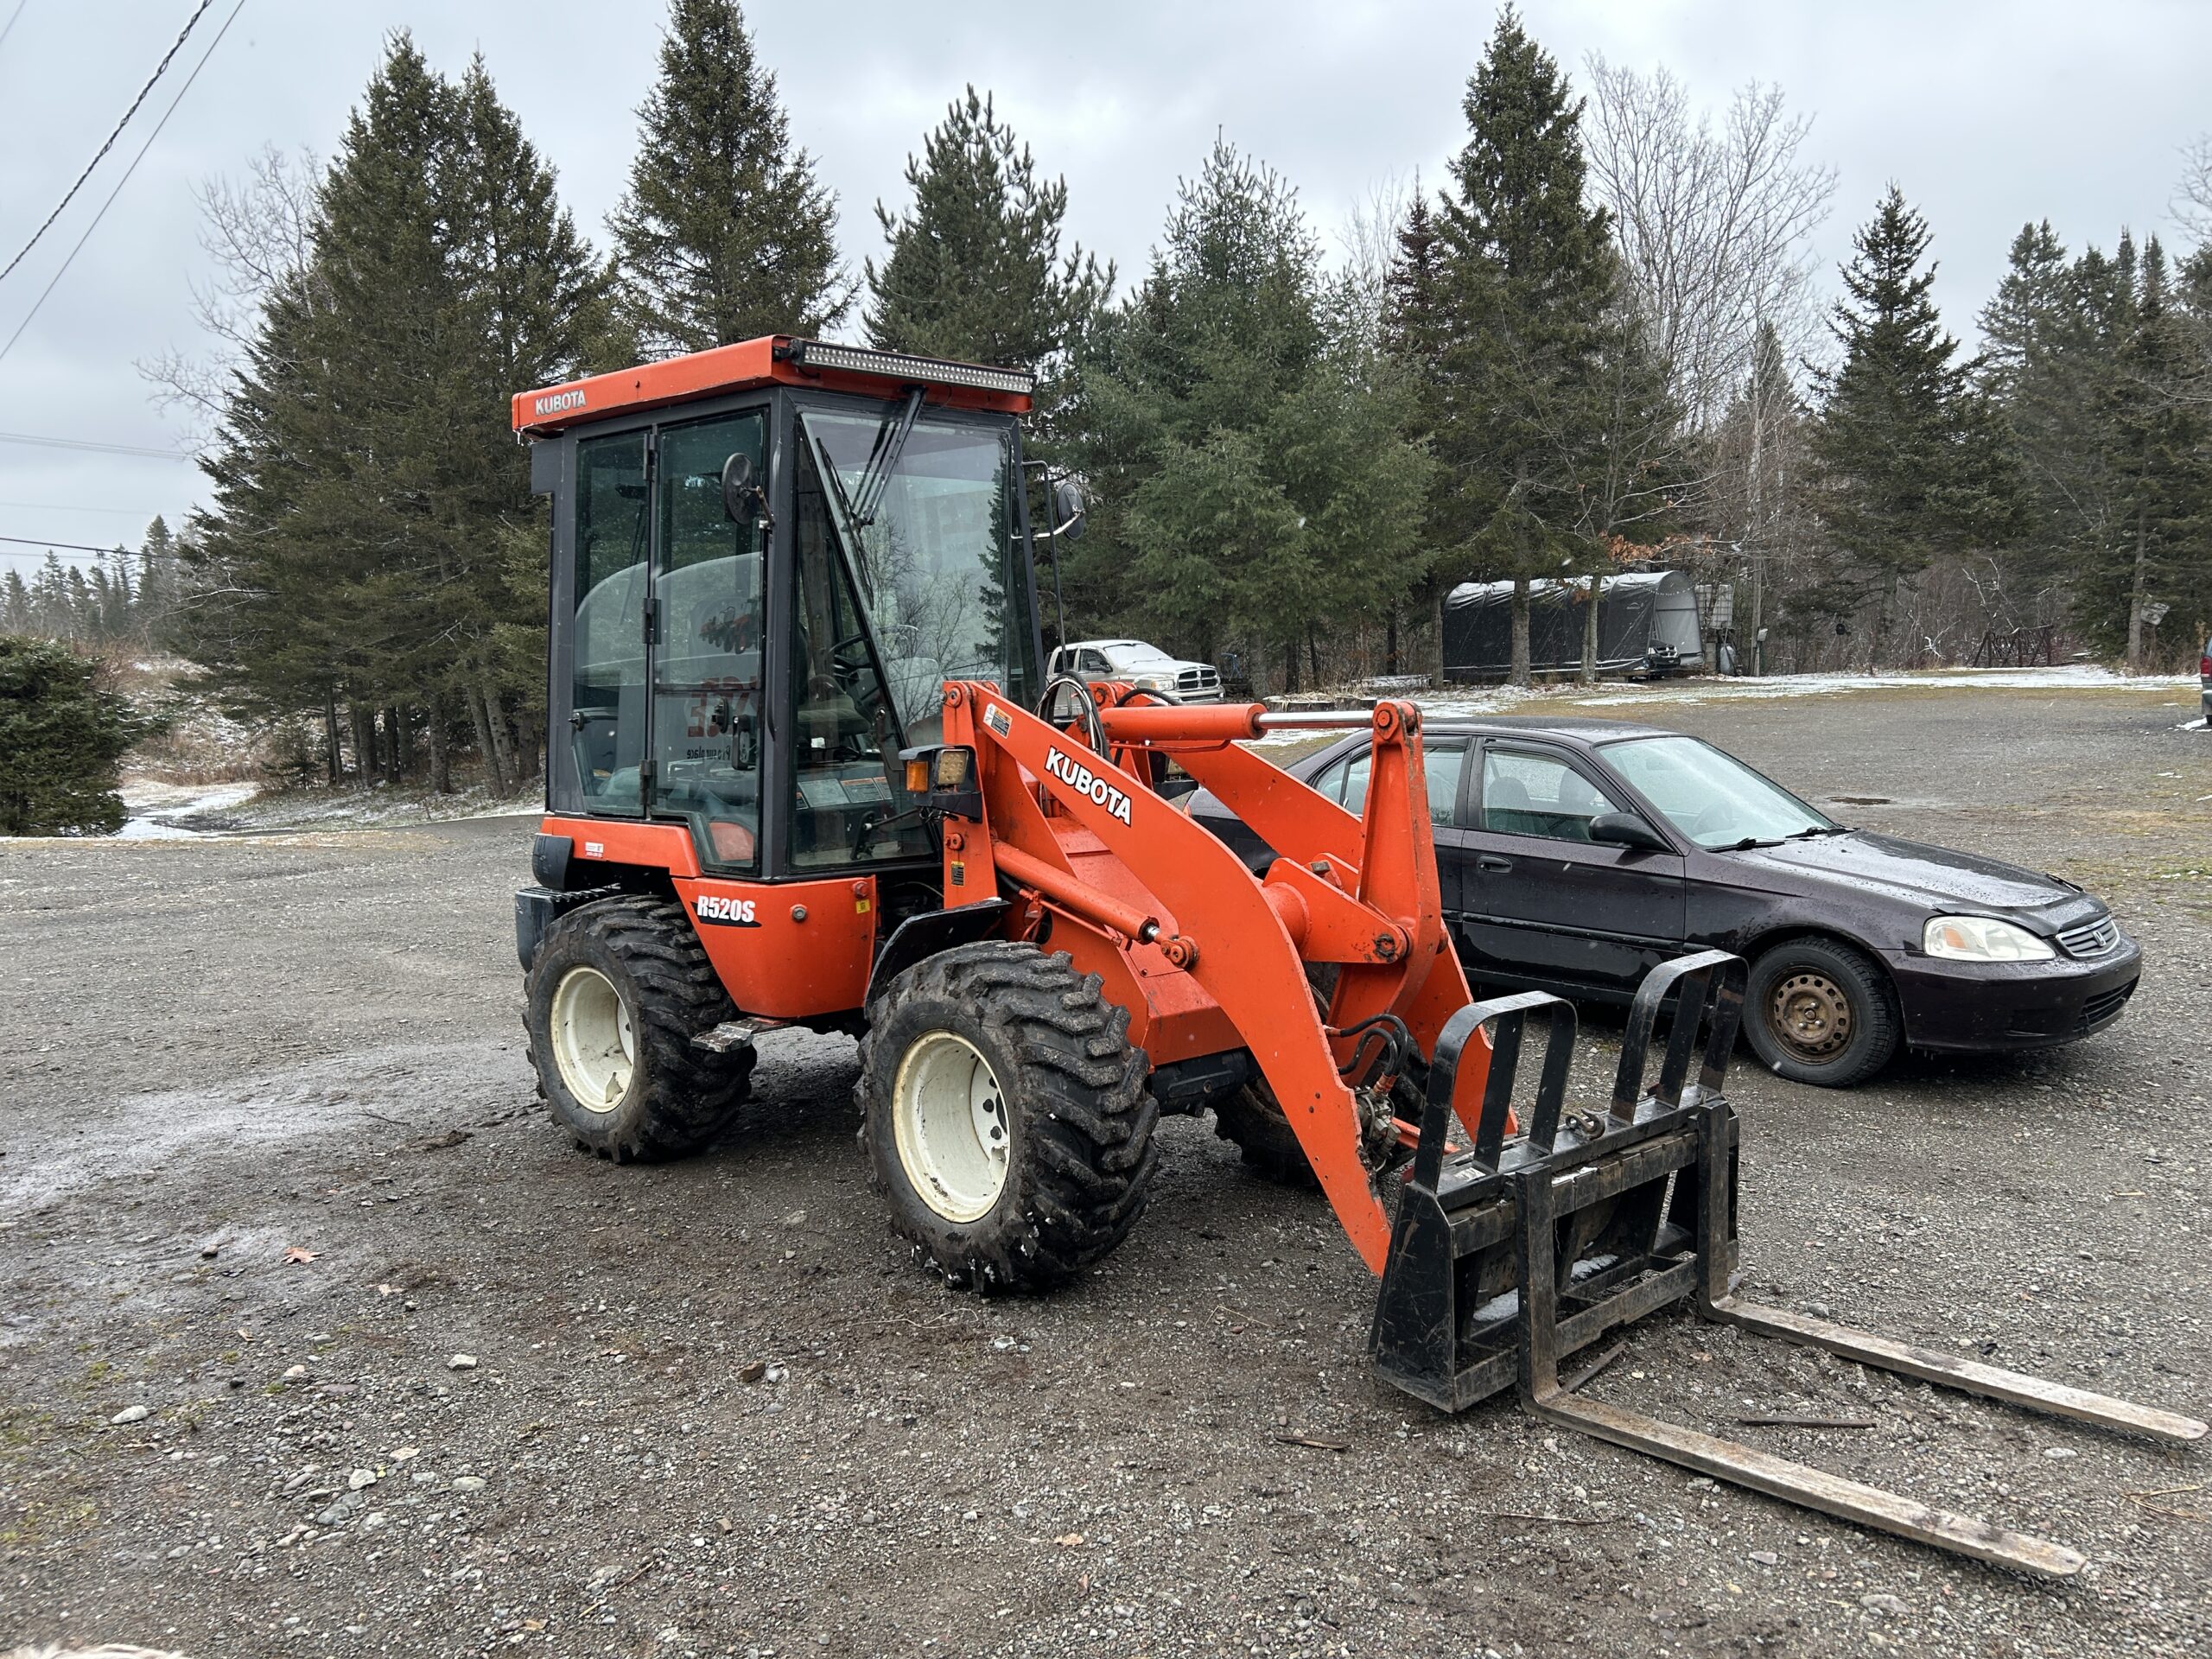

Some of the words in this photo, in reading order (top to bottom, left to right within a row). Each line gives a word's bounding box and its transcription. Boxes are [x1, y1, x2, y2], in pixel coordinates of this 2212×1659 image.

[535, 389, 587, 416] KUBOTA
[1044, 745, 1132, 828] KUBOTA
[696, 894, 756, 923] R520S
